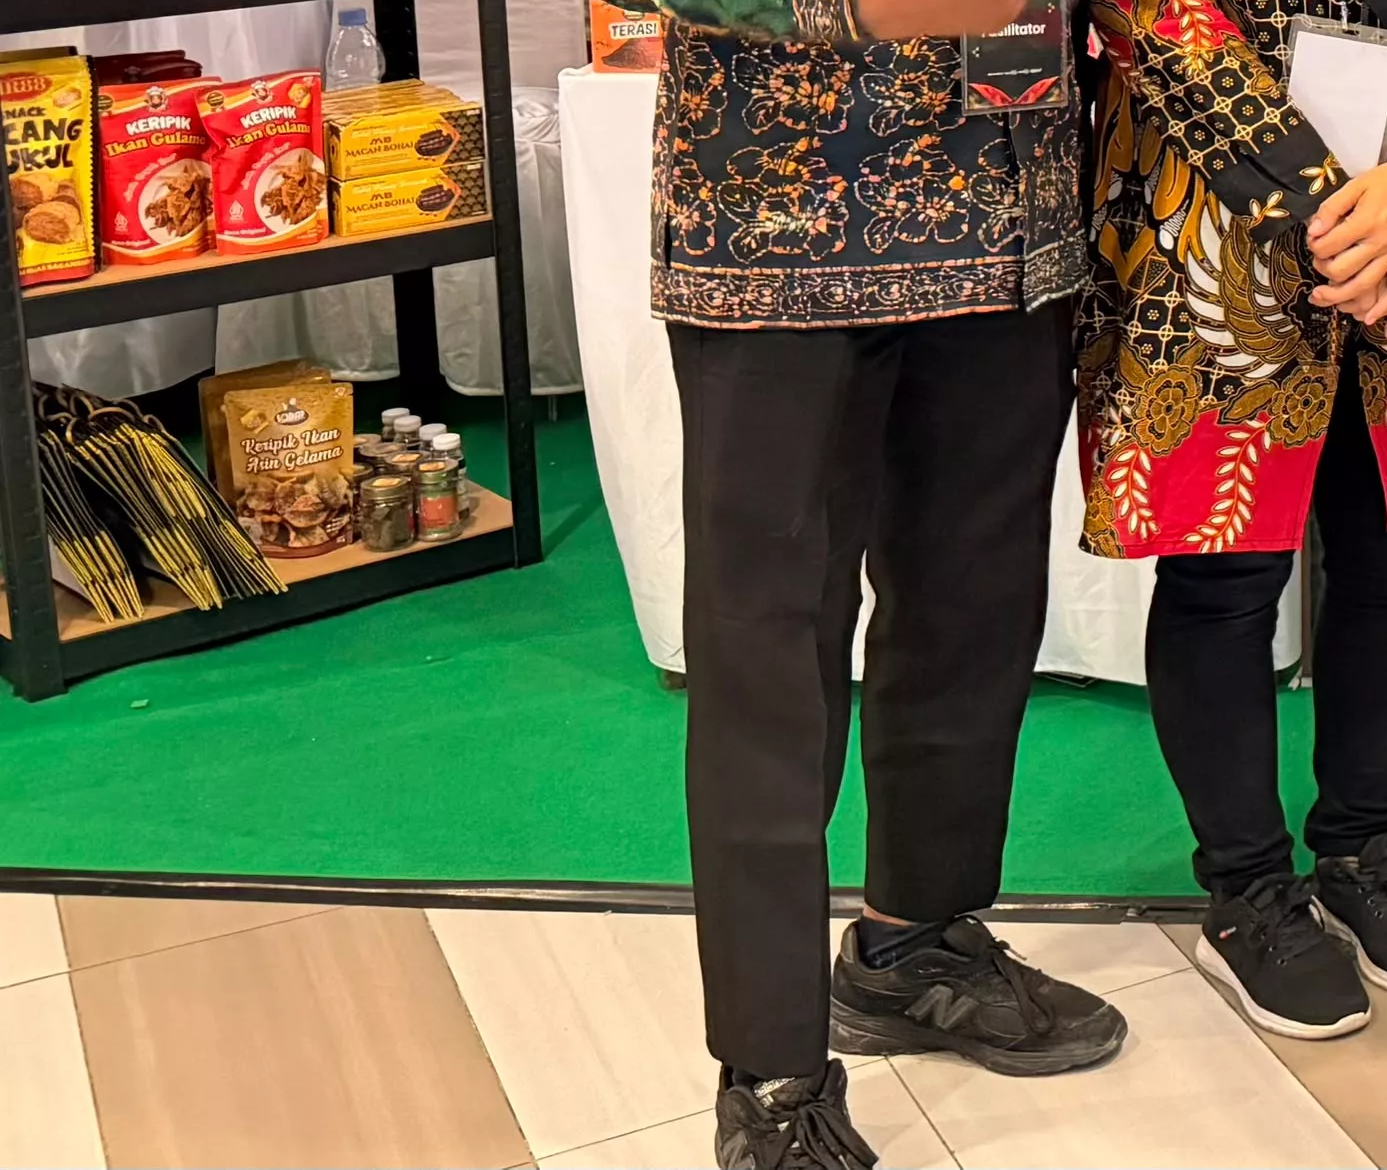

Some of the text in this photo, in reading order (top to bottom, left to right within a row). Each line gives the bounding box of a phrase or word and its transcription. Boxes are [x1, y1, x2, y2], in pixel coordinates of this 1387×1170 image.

[611, 22, 657, 37] TERASI
[981, 22, 1047, 38] ilitator
[125, 116, 192, 137] KERIPIK
[240, 105, 297, 129] KERIPIK
[105, 135, 149, 158] Ikan
[225, 129, 263, 149] Ikan
[7, 143, 75, 175] UKUL
[241, 428, 340, 455] Keripik Ikan
[247, 446, 343, 474] Asin Gelama
